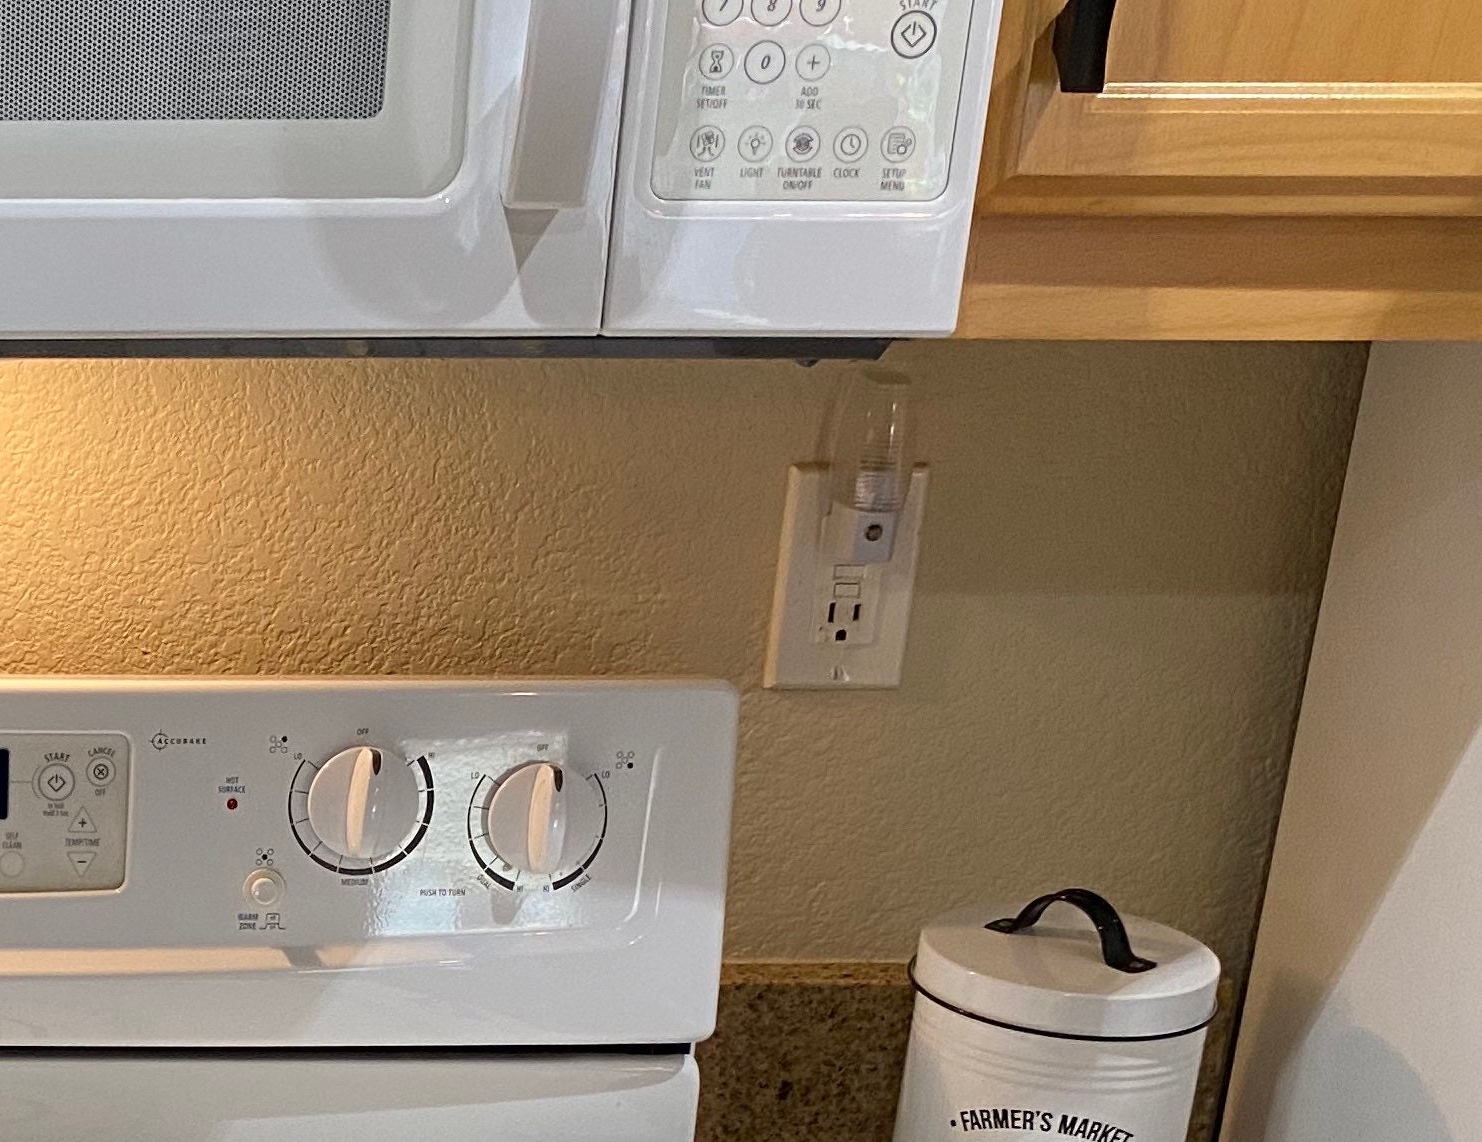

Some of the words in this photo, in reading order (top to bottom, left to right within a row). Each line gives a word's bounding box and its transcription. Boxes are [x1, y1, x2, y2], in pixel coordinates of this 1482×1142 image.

[701, 86, 727, 96] TIMER
[694, 167, 715, 178] VENT
[740, 167, 764, 178] LIGHT
[777, 167, 822, 178] TURNTABLE
[833, 167, 861, 178] CLOCK
[882, 167, 907, 178] SETUP
[694, 180, 711, 190] FAN
[880, 180, 906, 191] MENU
[357, 728, 369, 736] OFF
[44, 752, 70, 763] START
[420, 888, 437, 897] PUSH
[438, 889, 447, 897] TO
[448, 889, 466, 897] TURN
[959, 1108, 1054, 1133] FARMER'S
